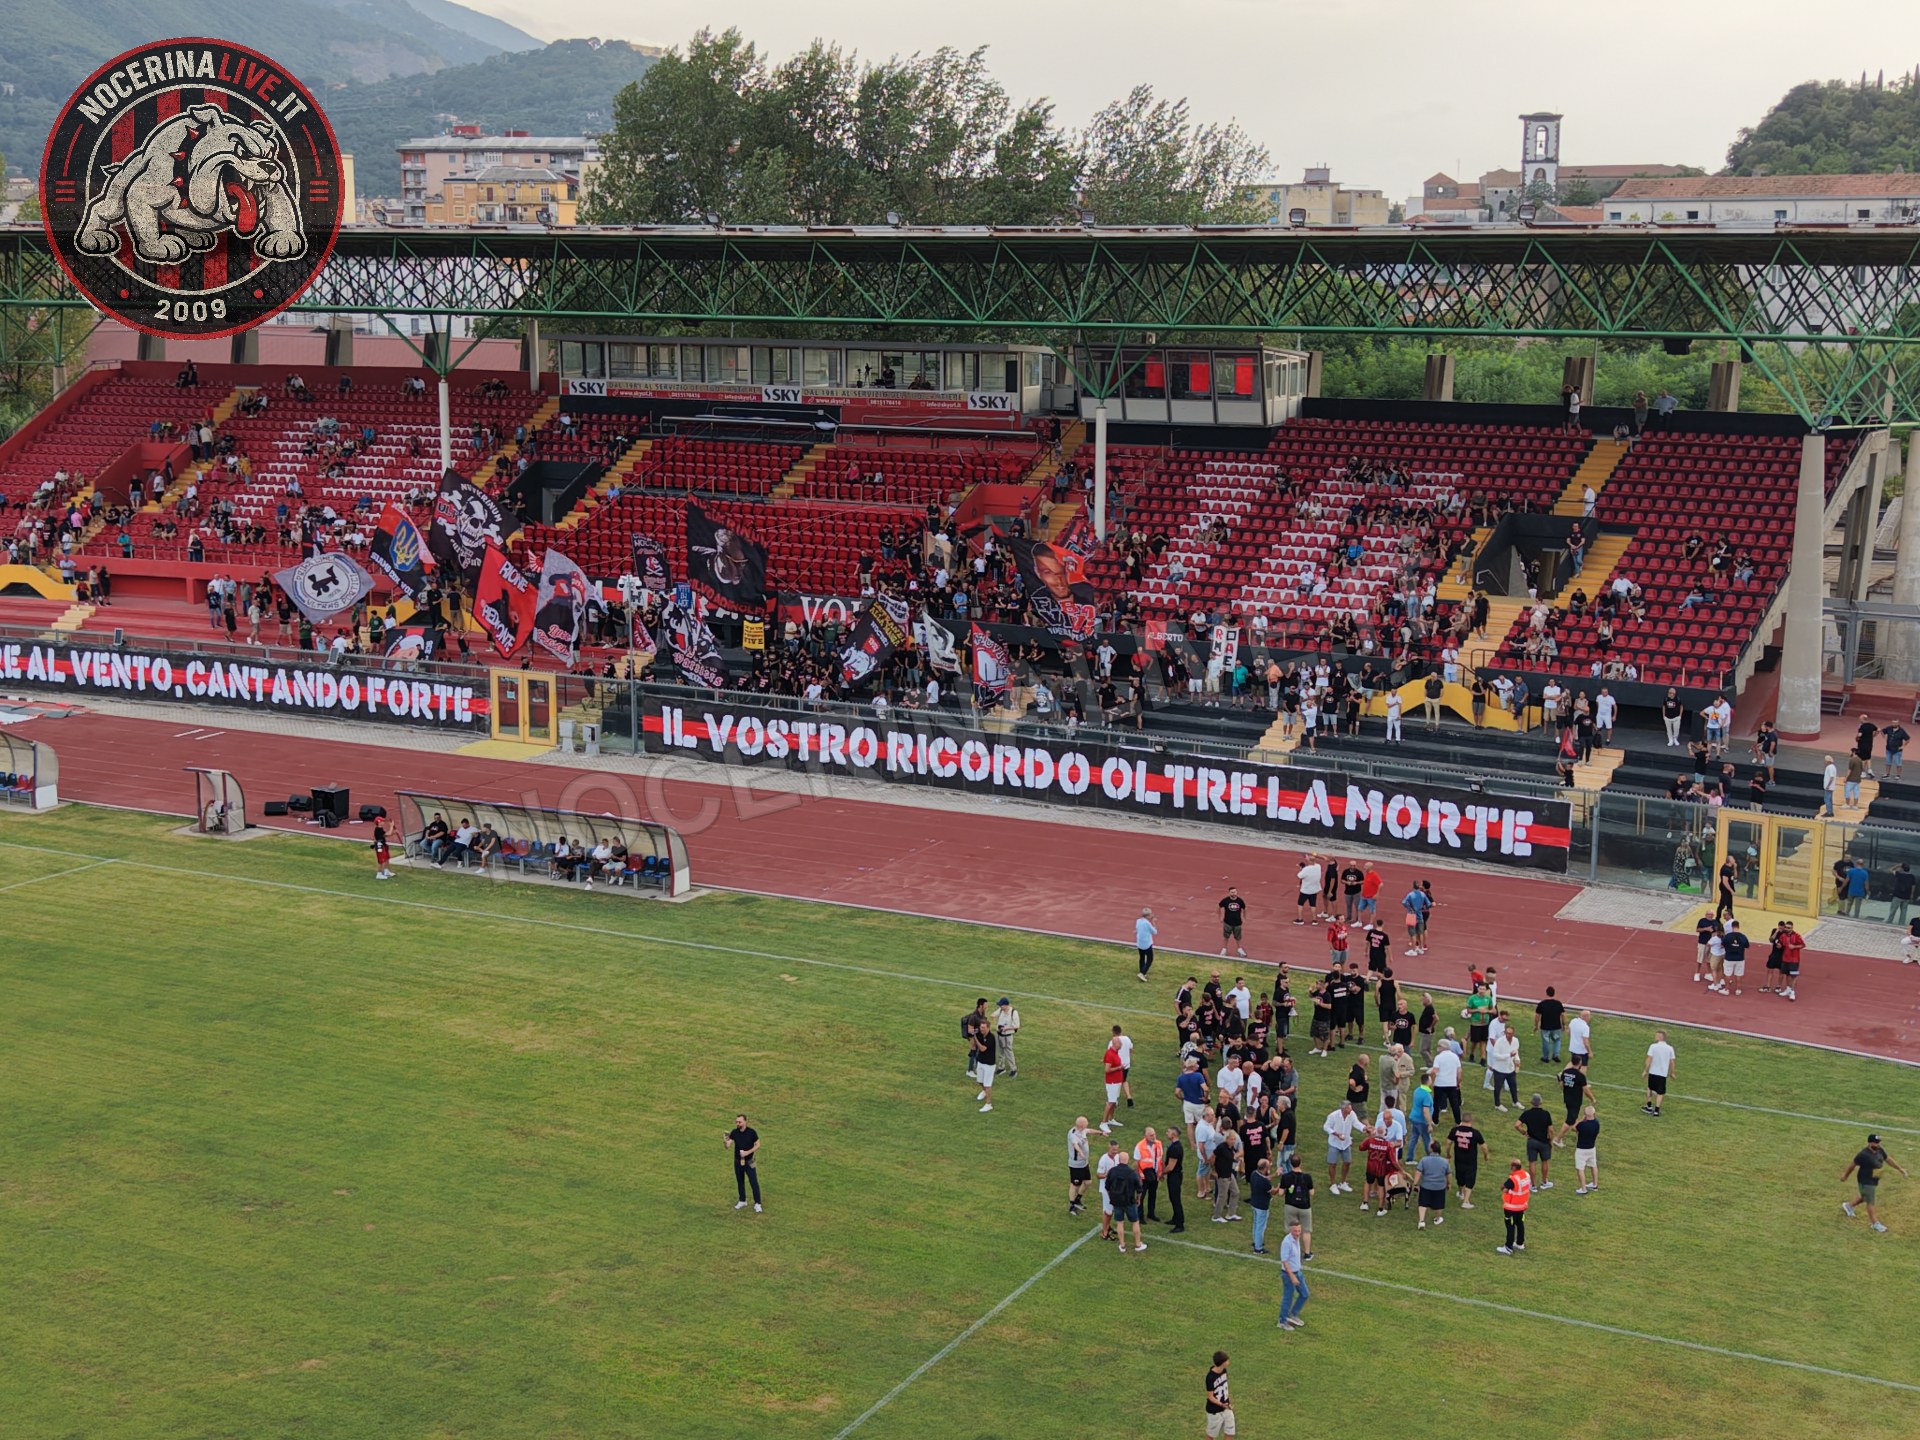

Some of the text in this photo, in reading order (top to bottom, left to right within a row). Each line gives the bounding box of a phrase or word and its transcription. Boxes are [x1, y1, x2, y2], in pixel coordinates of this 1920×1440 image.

[578, 381, 606, 395] SKY
[772, 388, 800, 402] SKY
[978, 395, 1009, 409] SKY
[499, 560, 529, 594] RIONE
[26, 646, 67, 683] AL
[69, 649, 184, 699] VENTO,
[186, 660, 361, 710] CANTANDO
[366, 675, 474, 723] FORTE
[661, 705, 1535, 857] IL VOSTRO RICORDO OLTRE LA MORTE
